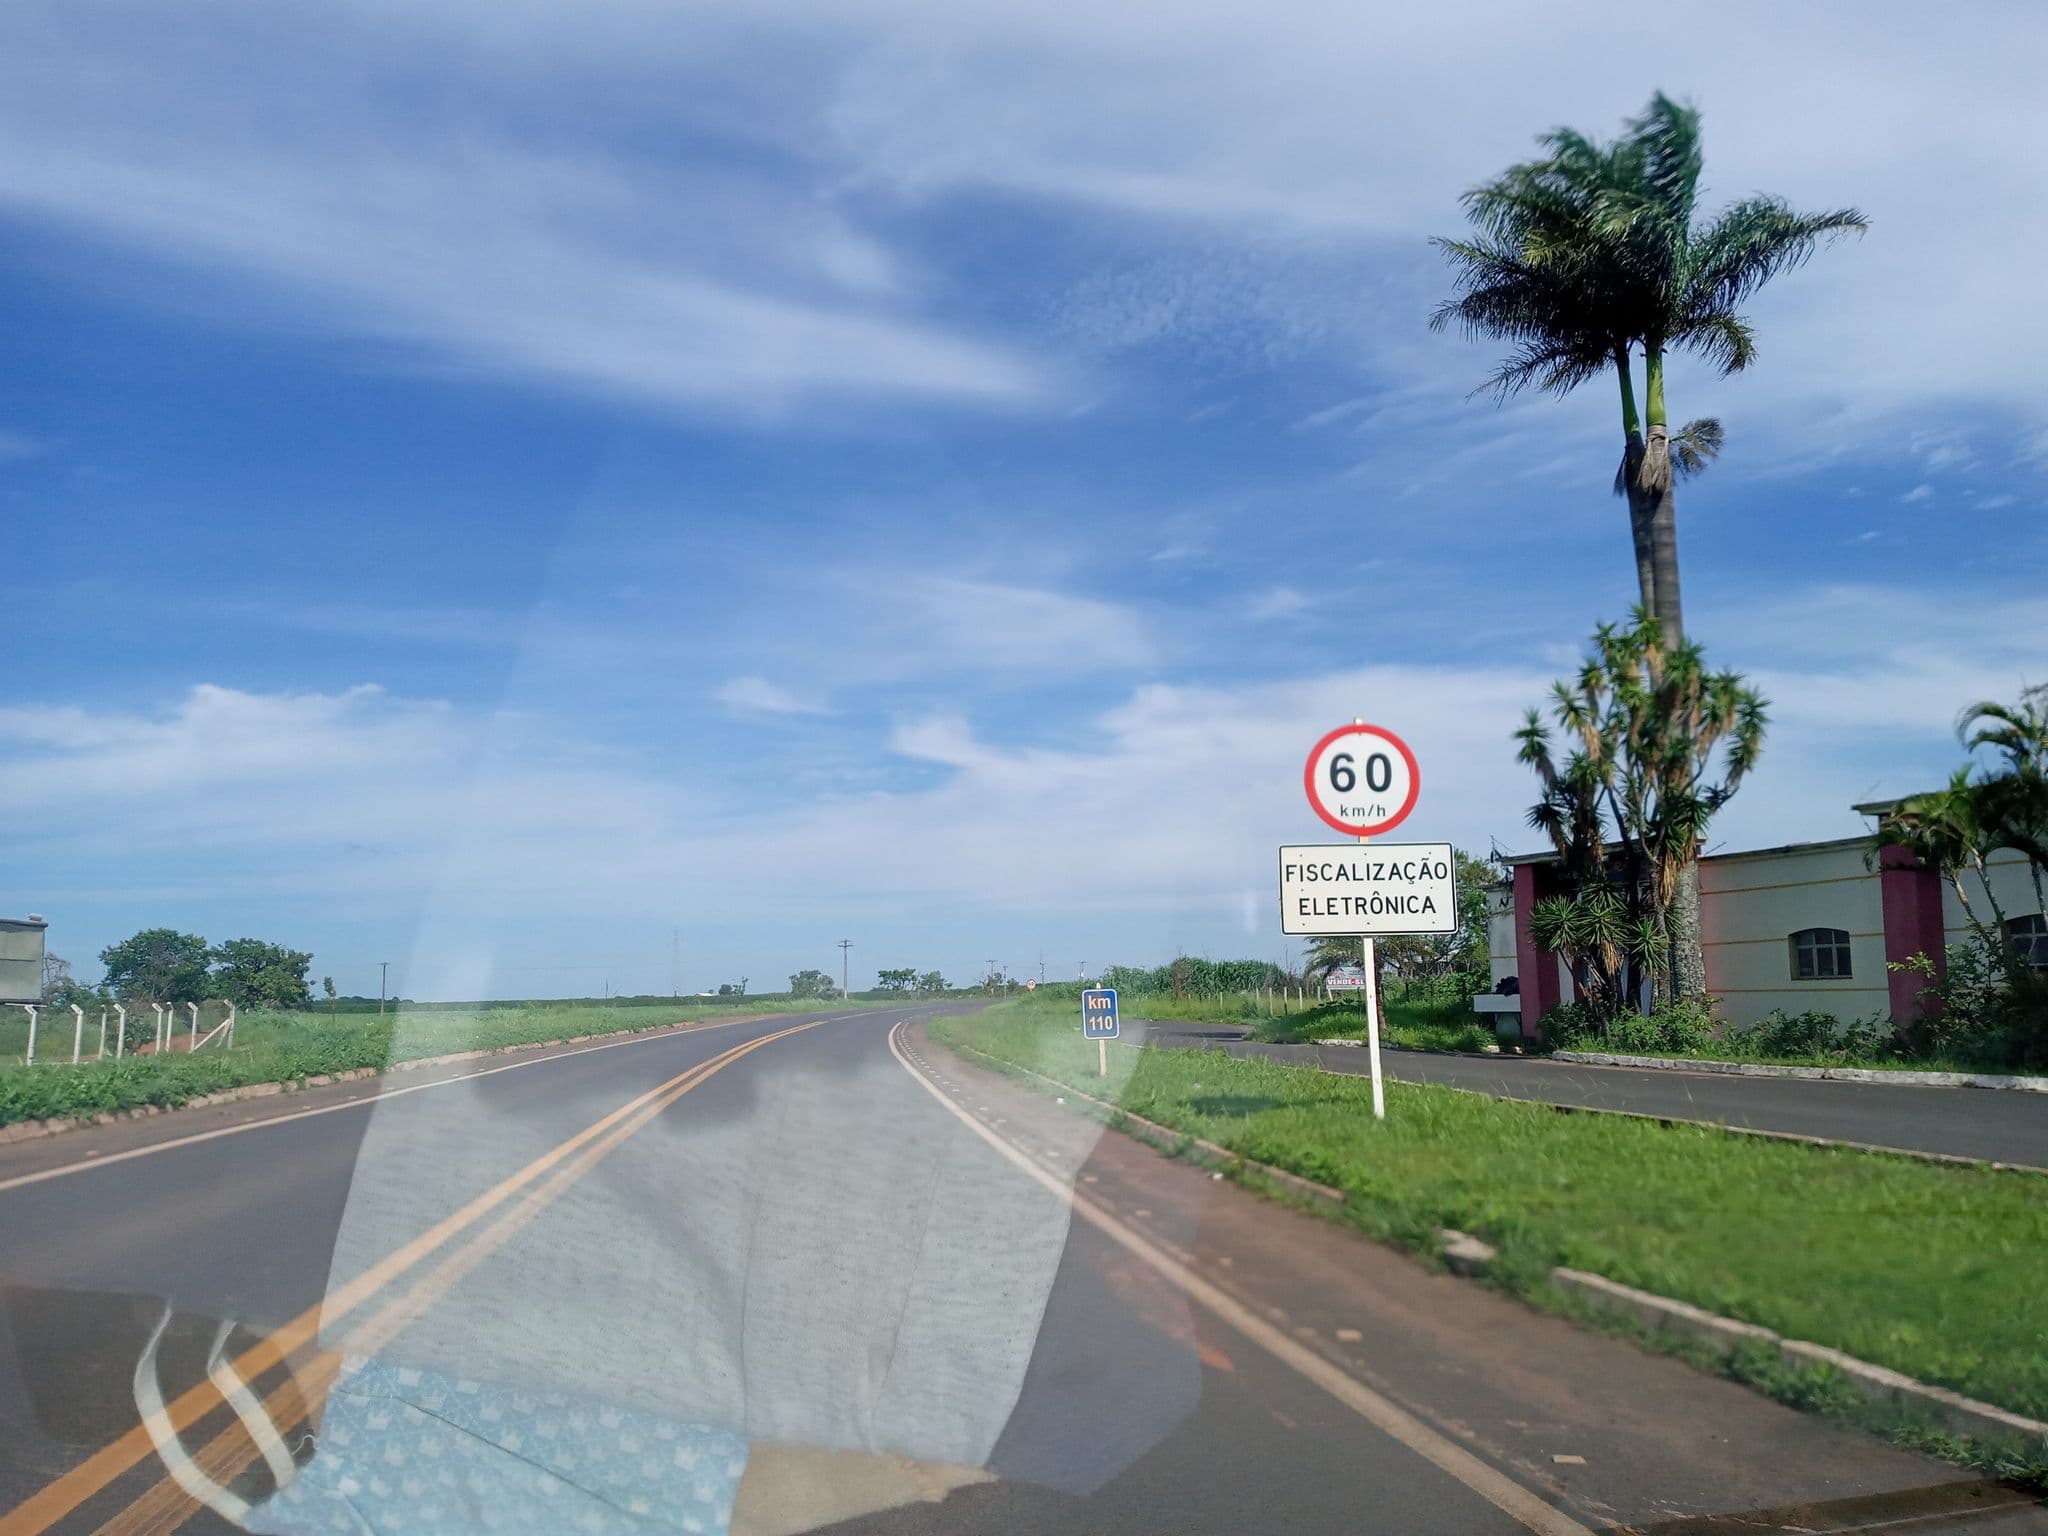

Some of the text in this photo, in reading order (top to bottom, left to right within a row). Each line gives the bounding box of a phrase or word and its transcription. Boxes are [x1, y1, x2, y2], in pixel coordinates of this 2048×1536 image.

[1329, 752, 1392, 793] 60
[1340, 804, 1386, 817] km/h
[1285, 857, 1448, 885] FISCALIZAÇÃO
[1299, 891, 1437, 916] ELETRÔNICA
[1088, 995, 1112, 1010] km
[1089, 1015, 1113, 1031] 110
